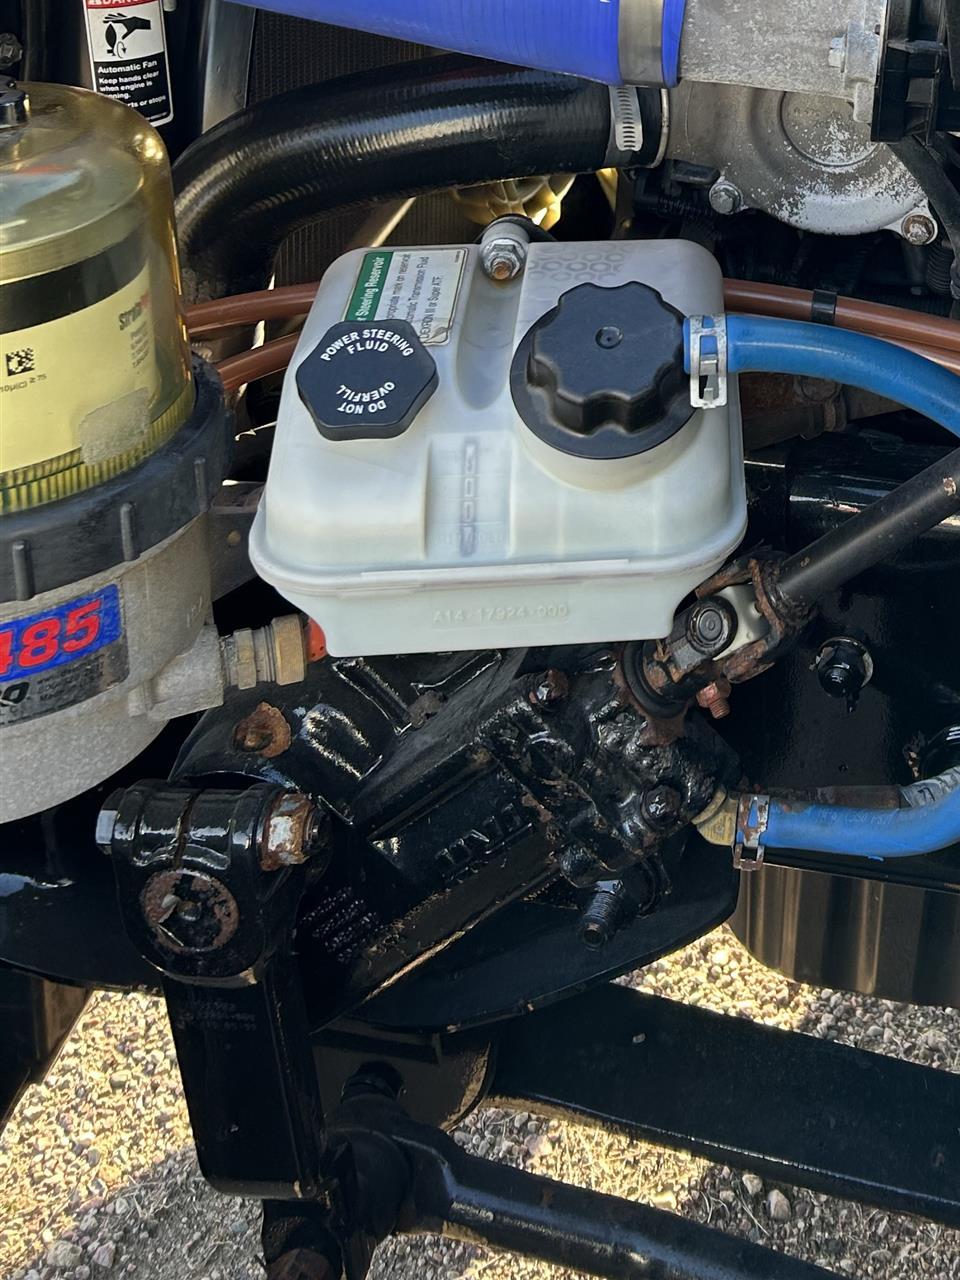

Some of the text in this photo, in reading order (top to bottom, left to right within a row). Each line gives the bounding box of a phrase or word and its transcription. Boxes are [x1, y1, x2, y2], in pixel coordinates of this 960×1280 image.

[98, 64, 141, 73] Automatic
[142, 71, 159, 79] clear
[120, 83, 145, 91] engine
[355, 256, 385, 316] Steering Reservoir
[320, 328, 414, 361] POWER STEERING
[347, 340, 389, 355] FLUID
[336, 381, 395, 402] OVERFILL
[337, 399, 387, 414] DO NOT
